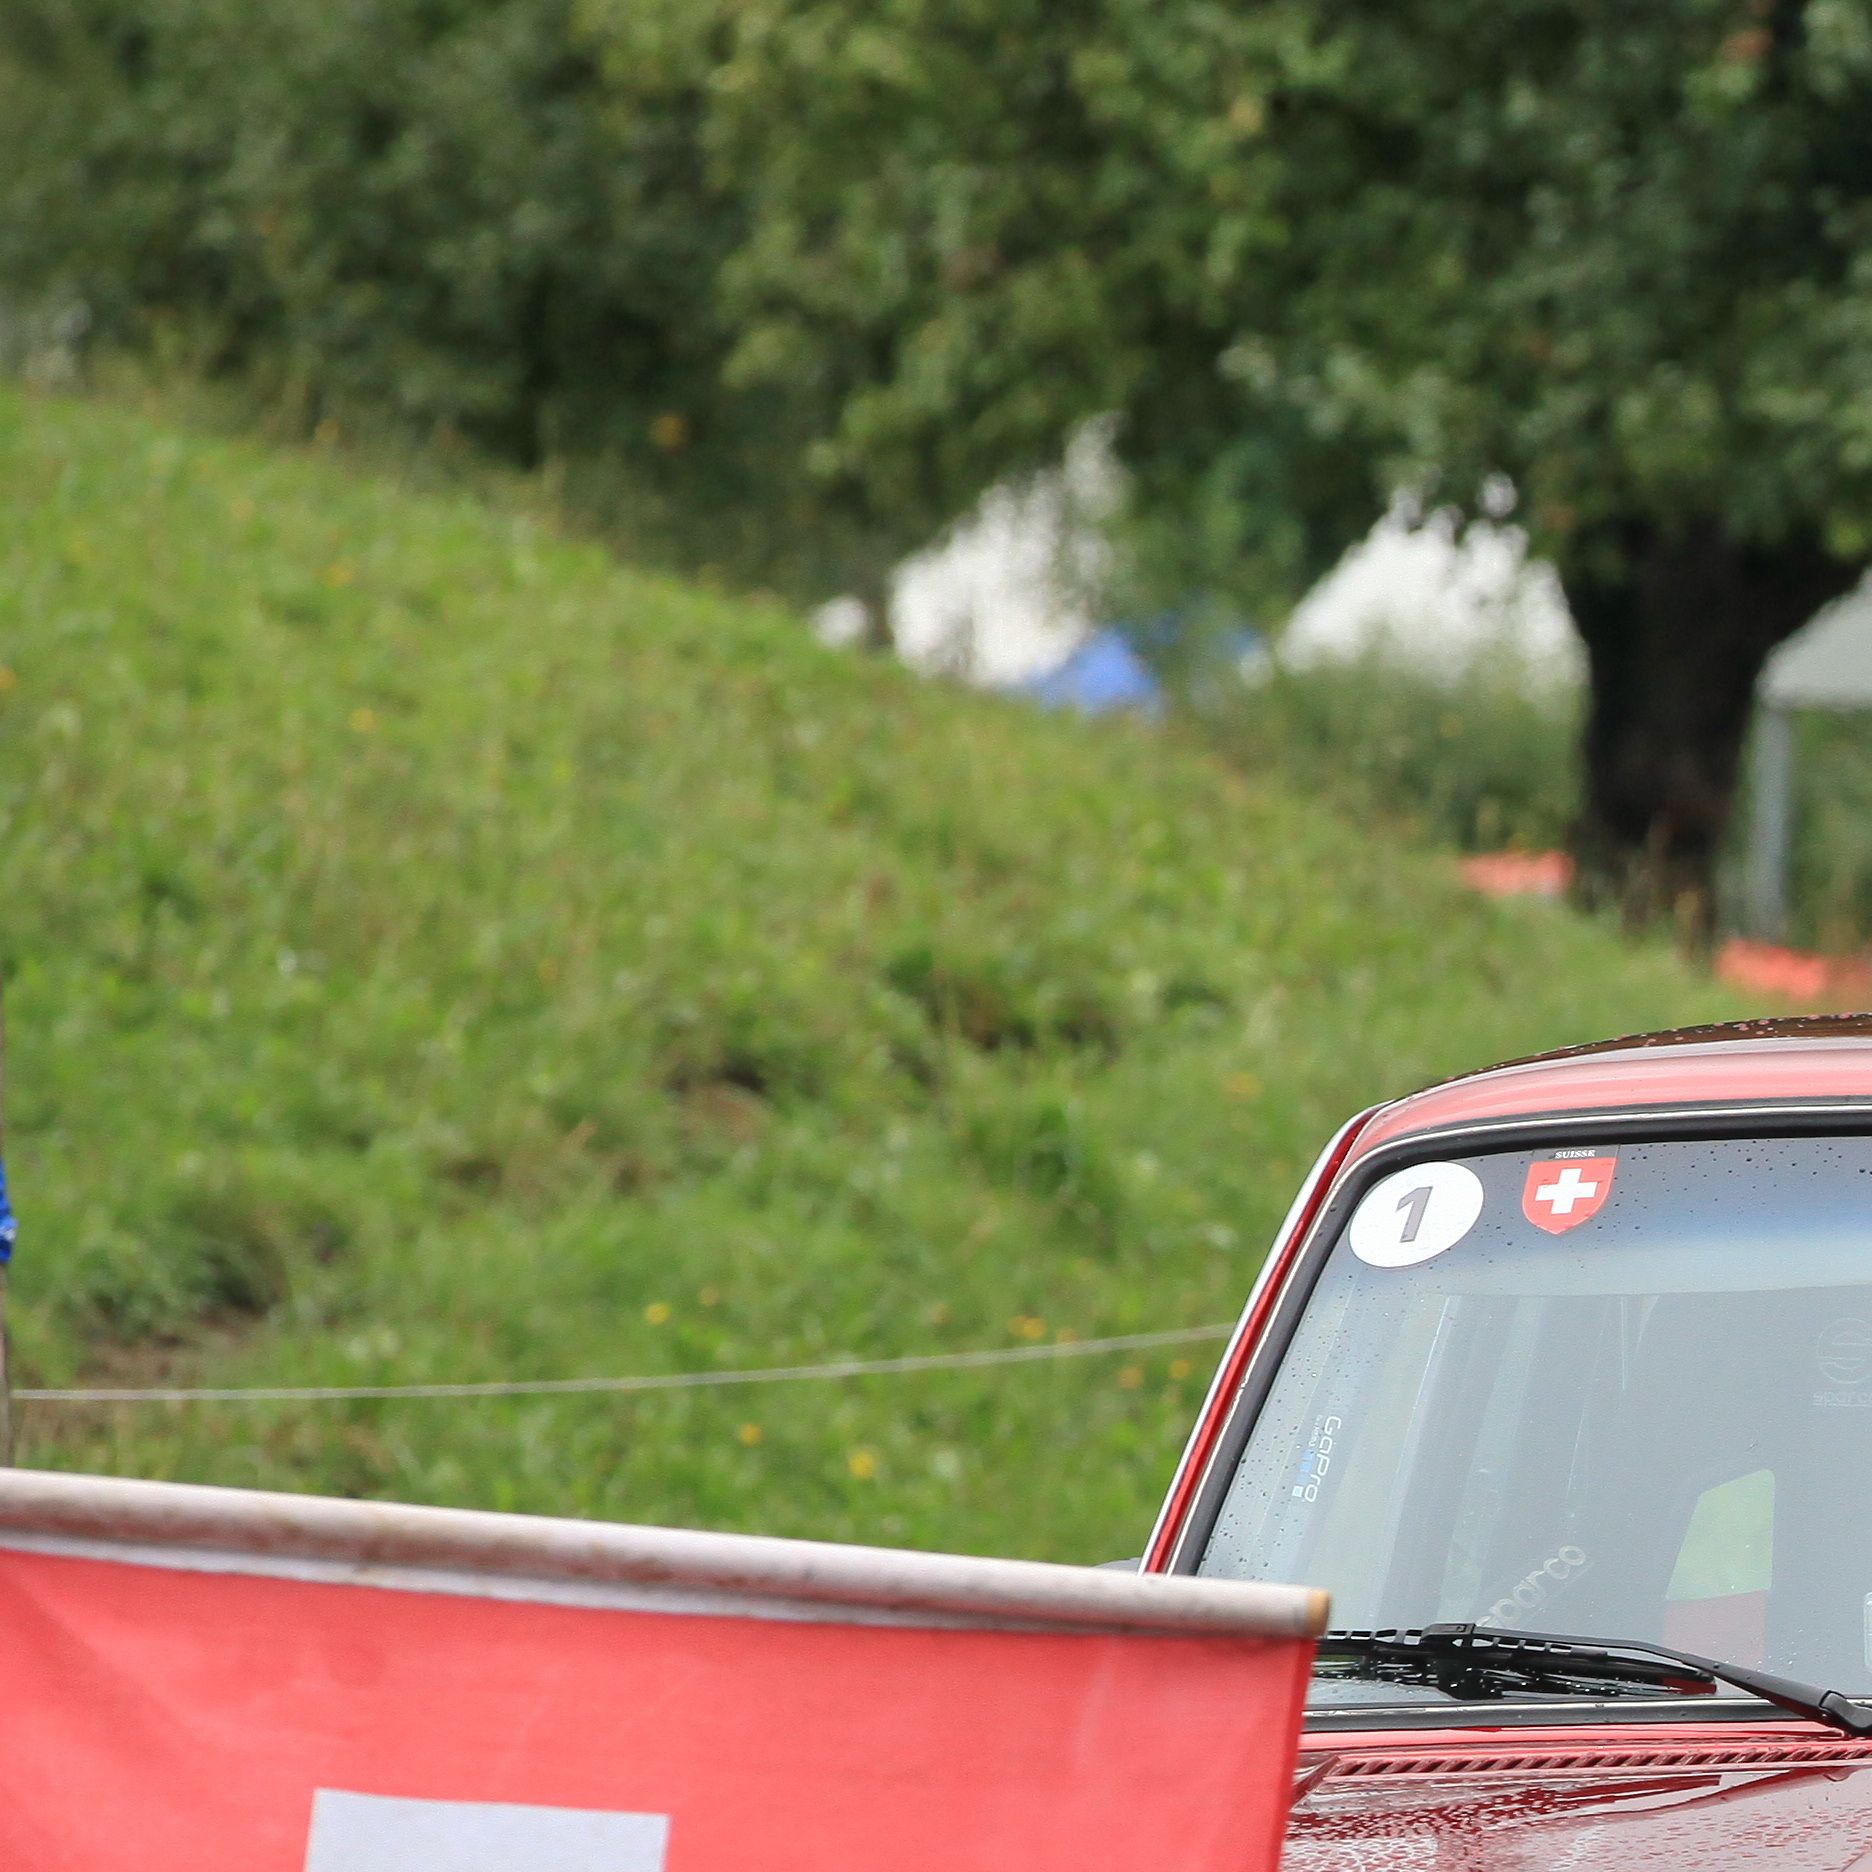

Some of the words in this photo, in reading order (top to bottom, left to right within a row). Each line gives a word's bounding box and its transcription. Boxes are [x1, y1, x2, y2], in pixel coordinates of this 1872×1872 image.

[1554, 1149, 1597, 1159] SUISSE
[1395, 1185, 1434, 1243] 1
[1304, 1416, 1342, 1502] GoPro
